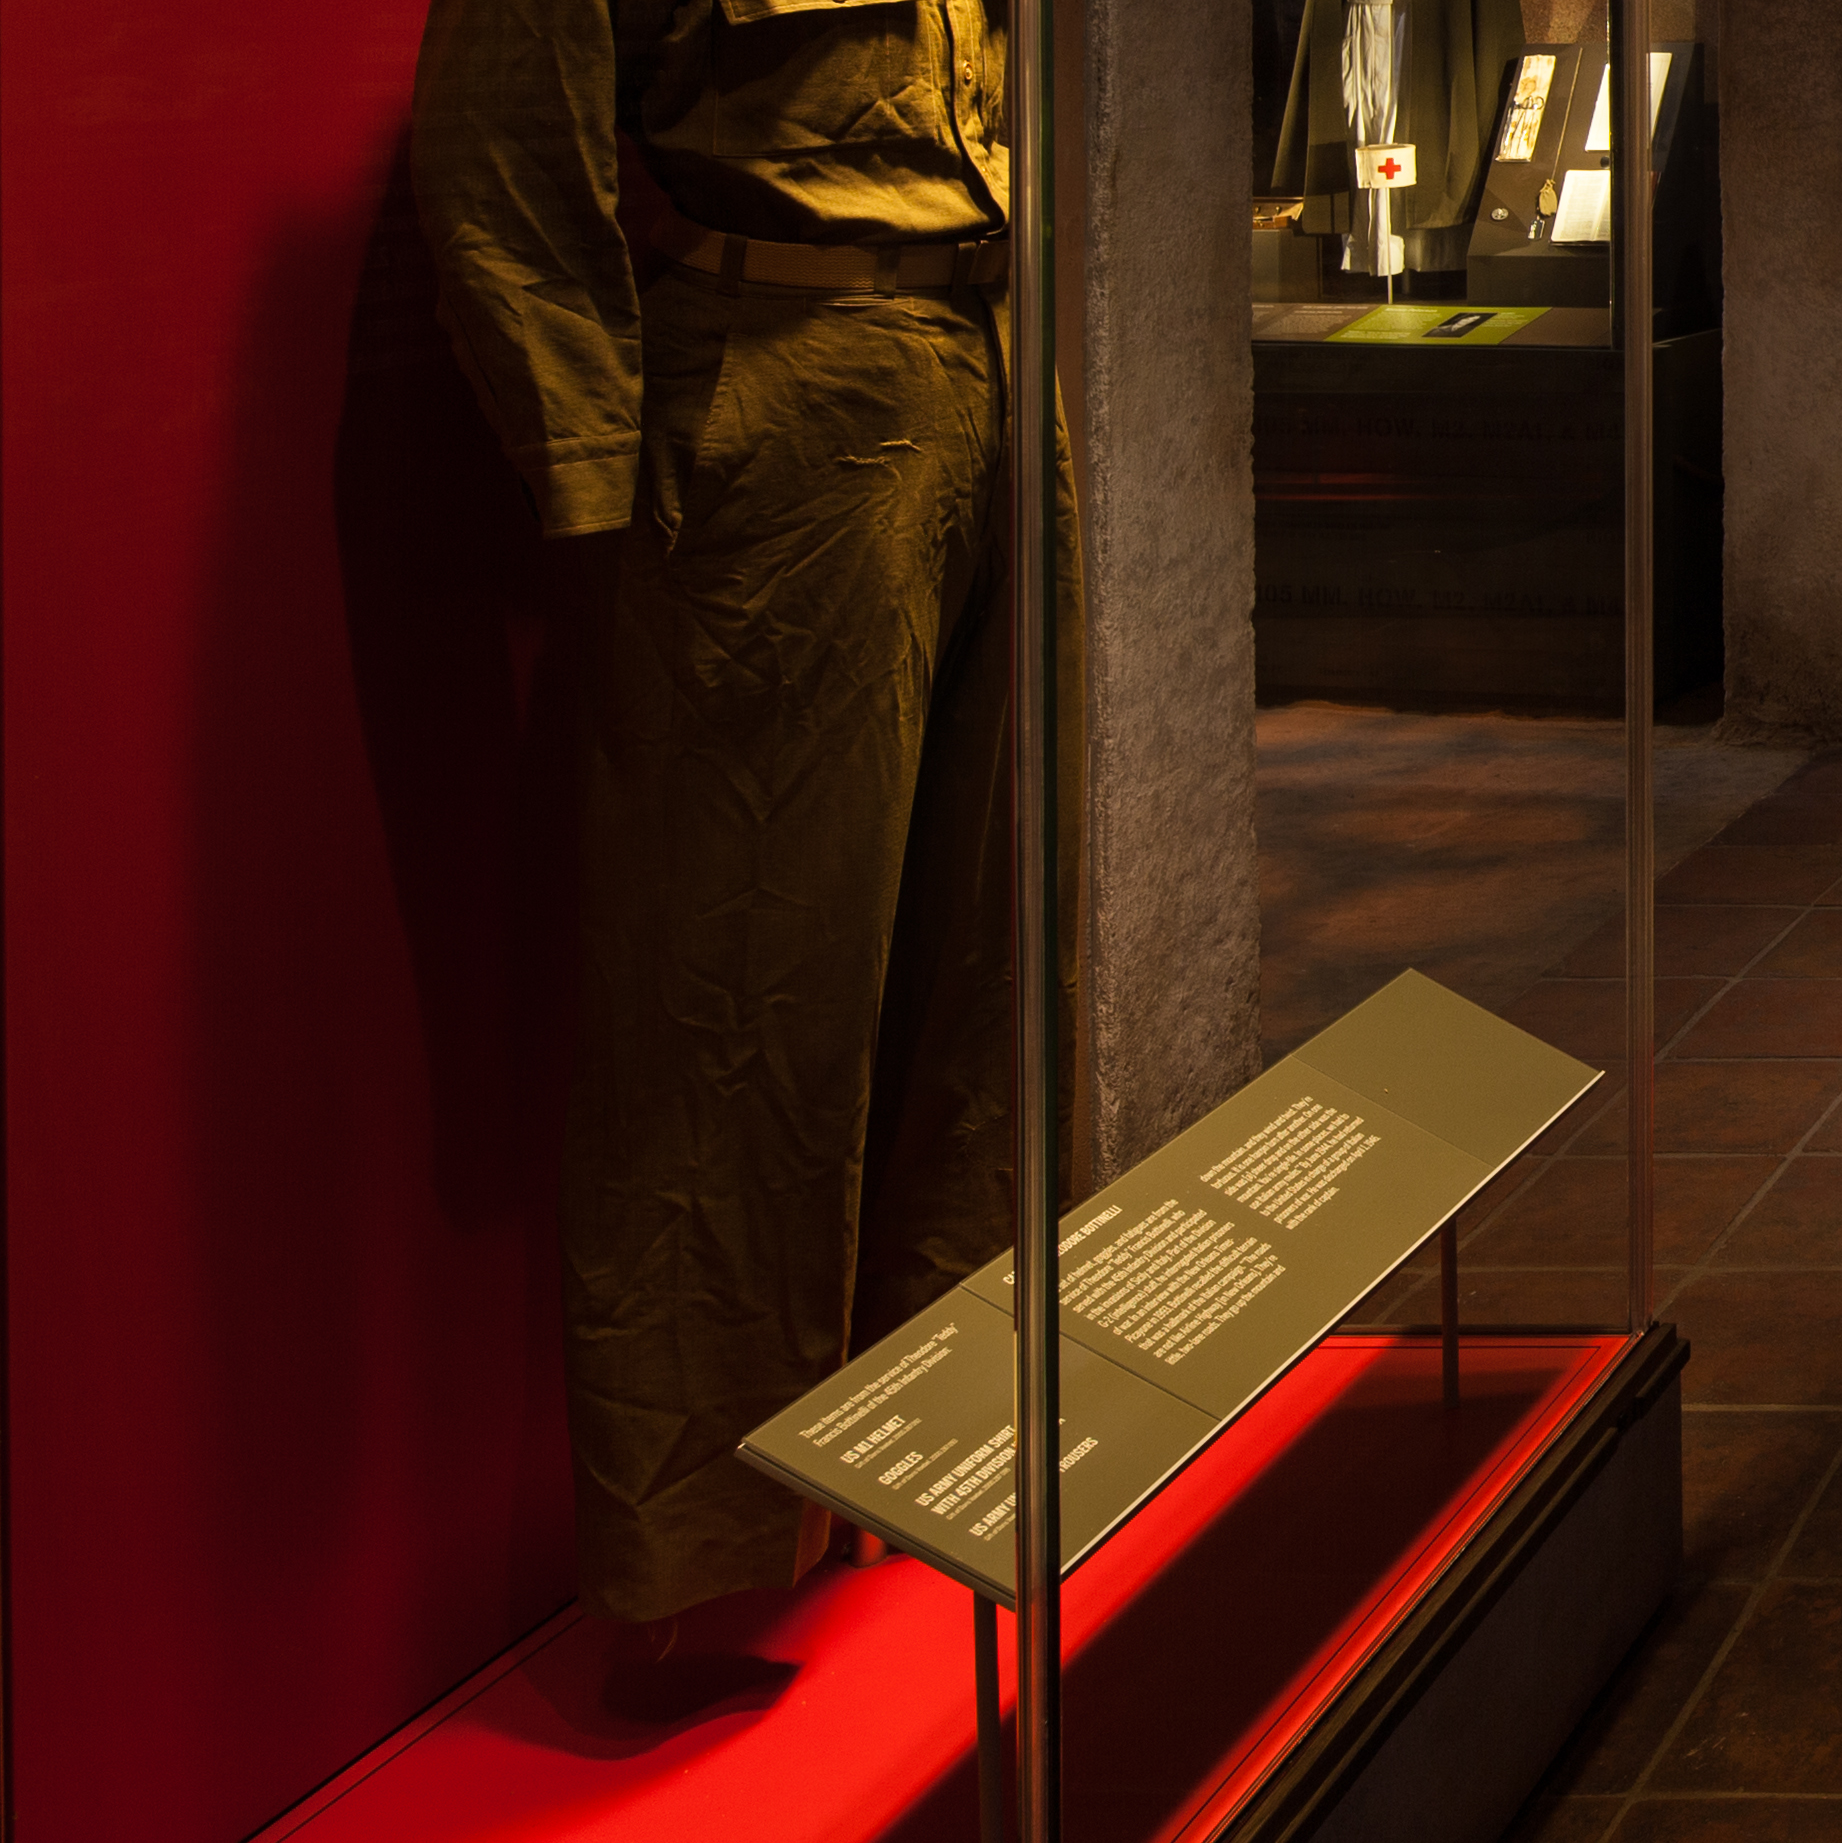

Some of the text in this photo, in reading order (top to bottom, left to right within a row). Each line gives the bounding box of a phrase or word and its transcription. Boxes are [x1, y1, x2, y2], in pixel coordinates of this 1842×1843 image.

[1080, 1204, 1123, 1236] BOTTINELLI
[904, 1340, 938, 1363] Theodore
[900, 1357, 909, 1368] of
[878, 1366, 903, 1385] service
[898, 1365, 928, 1386] Infantry
[849, 1389, 870, 1404] from
[865, 1381, 881, 1393] the
[884, 1382, 903, 1396] 45th
[840, 1400, 855, 1413] are
[867, 1400, 878, 1410] of
[872, 1392, 889, 1405] the
[820, 1409, 844, 1425] items
[836, 1406, 871, 1430] Bottinelli
[798, 1422, 826, 1438] These
[813, 1427, 843, 1447] Francis
[840, 1414, 906, 1464] US M1 HELMET
[878, 1451, 924, 1486] GOGGLES
[915, 1424, 1016, 1507] US ARMY UNIFORM SHIRT
[930, 1447, 1017, 1516] WITH 45TH DIVISION
[969, 1522, 989, 1537] US
[982, 1502, 1012, 1527] ARMY
